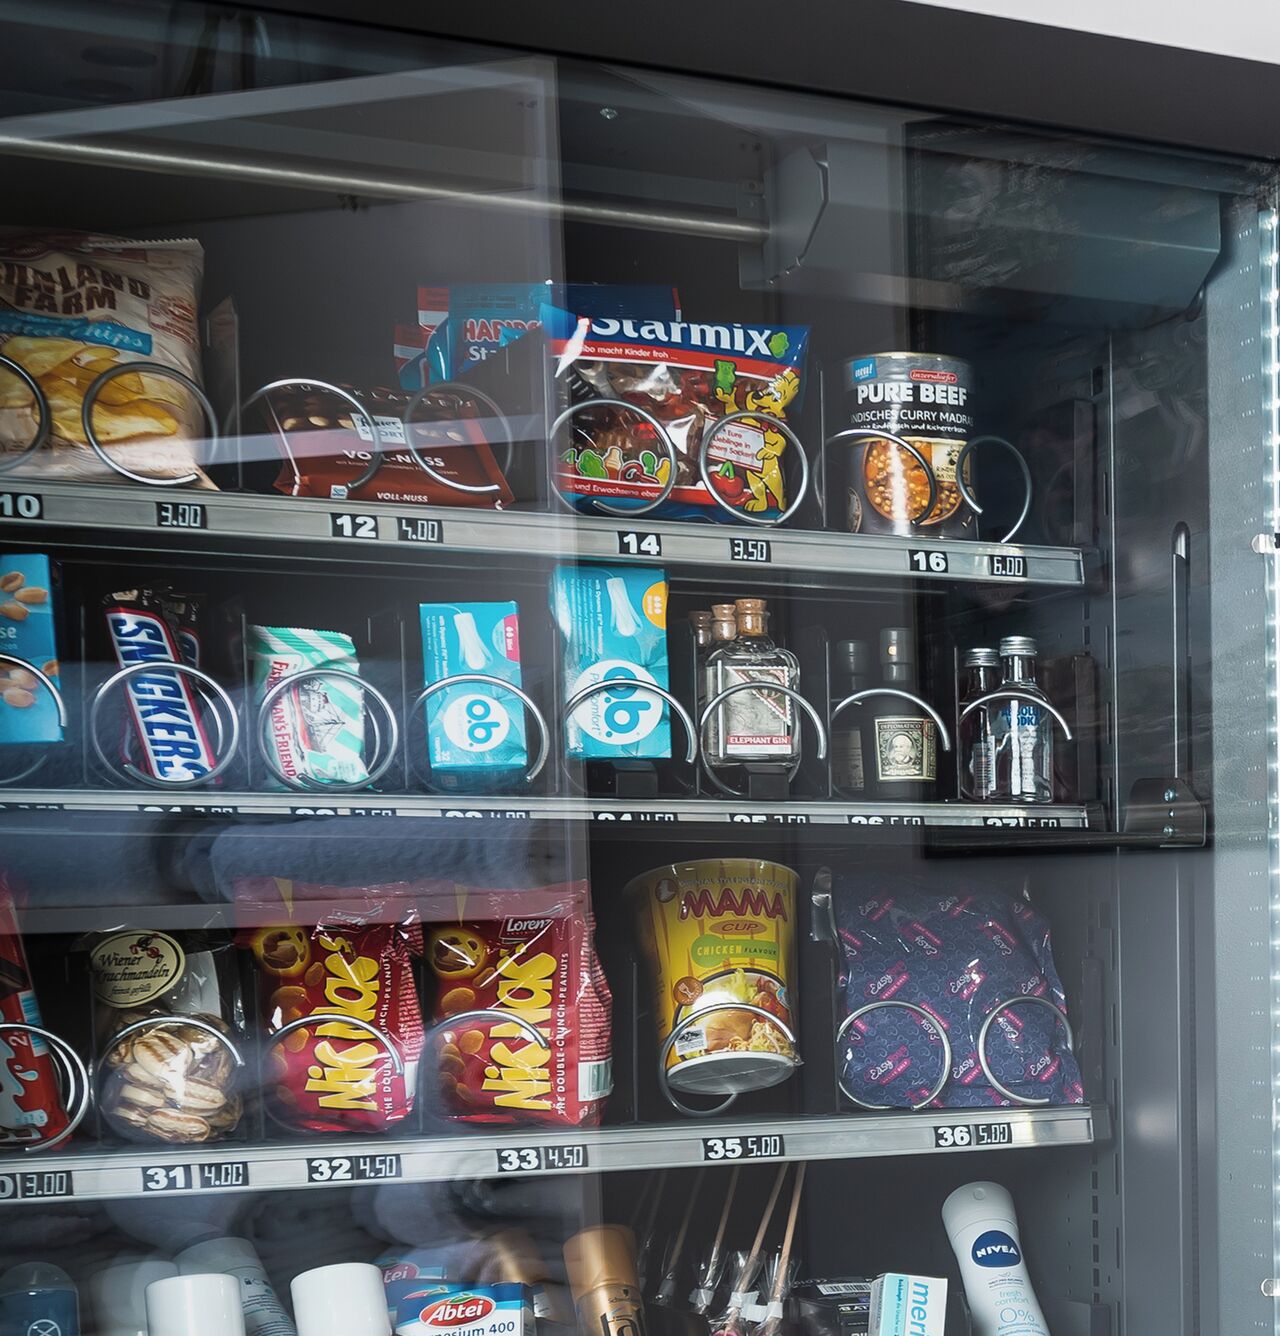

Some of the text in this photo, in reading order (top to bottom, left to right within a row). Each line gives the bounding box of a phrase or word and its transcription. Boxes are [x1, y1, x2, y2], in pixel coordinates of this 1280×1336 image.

[591, 319, 772, 357] Starmix
[597, 346, 650, 359] macht Kinder
[857, 382, 967, 406] PURE BEEF
[901, 409, 937, 422] CURRY
[376, 492, 428, 502] VOLL-NUSS
[335, 515, 438, 541] 12 4.00
[622, 533, 767, 561] 14 3.50
[913, 551, 1024, 576] 16 6.00
[602, 666, 652, 738] o.b.
[465, 699, 501, 748] o.b.
[729, 735, 789, 745] ELEPHANT GIN
[680, 887, 788, 921] MAMA
[721, 922, 759, 932] CUP
[100, 952, 143, 967] Wiener
[697, 946, 742, 957] CHICKEN
[707, 1136, 780, 1159] 35 5.00
[937, 1127, 971, 1147] 36
[311, 1156, 397, 1181] 32 4.50
[500, 1147, 583, 1171] 33 4.50
[26, 1174, 66, 1196] 3.00
[146, 1164, 243, 1190] 31 4.00
[976, 1245, 1018, 1258] NIVEA
[994, 1296, 1030, 1307] comfort
[999, 1290, 1022, 1299] fresh
[429, 1300, 484, 1323] Abtei
[999, 1308, 1035, 1323] 0%
[489, 1321, 515, 1335] 400
